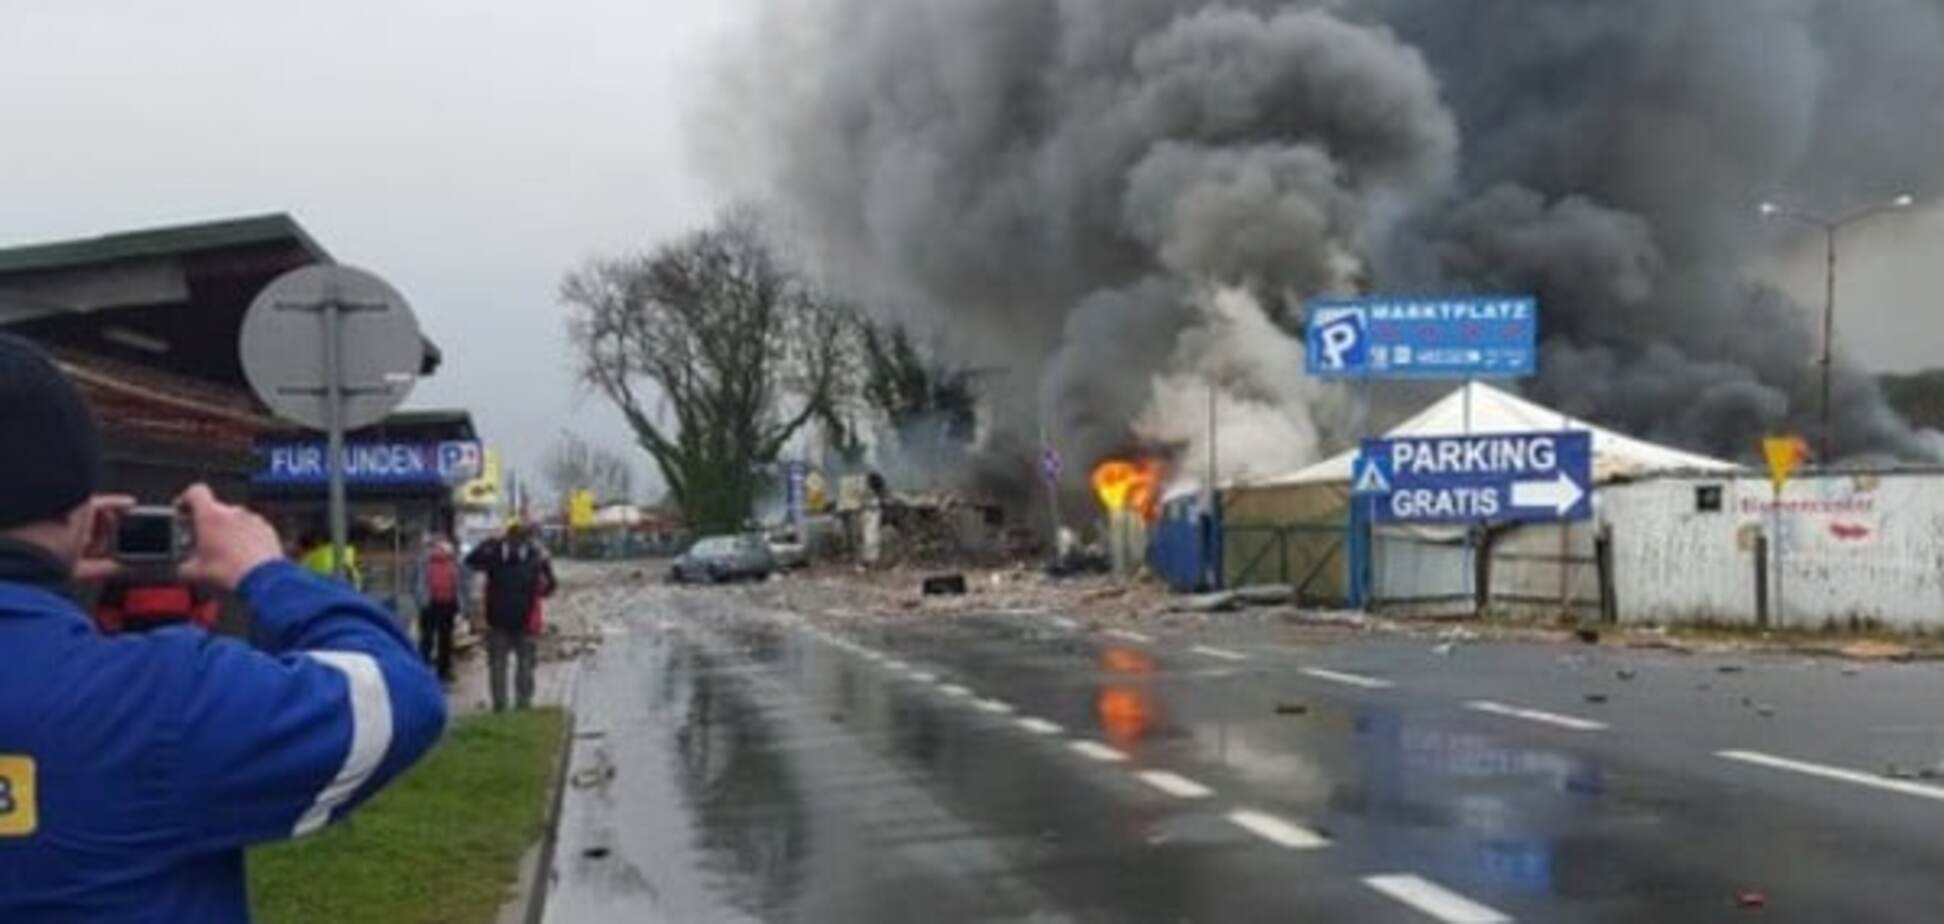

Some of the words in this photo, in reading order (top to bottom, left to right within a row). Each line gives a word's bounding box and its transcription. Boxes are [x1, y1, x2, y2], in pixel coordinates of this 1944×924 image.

[1371, 303, 1529, 319] MARKTPLATZ
[331, 444, 423, 475] UNDEN
[1392, 437, 1557, 473] PARKING
[1391, 487, 1499, 517] GRATIS
